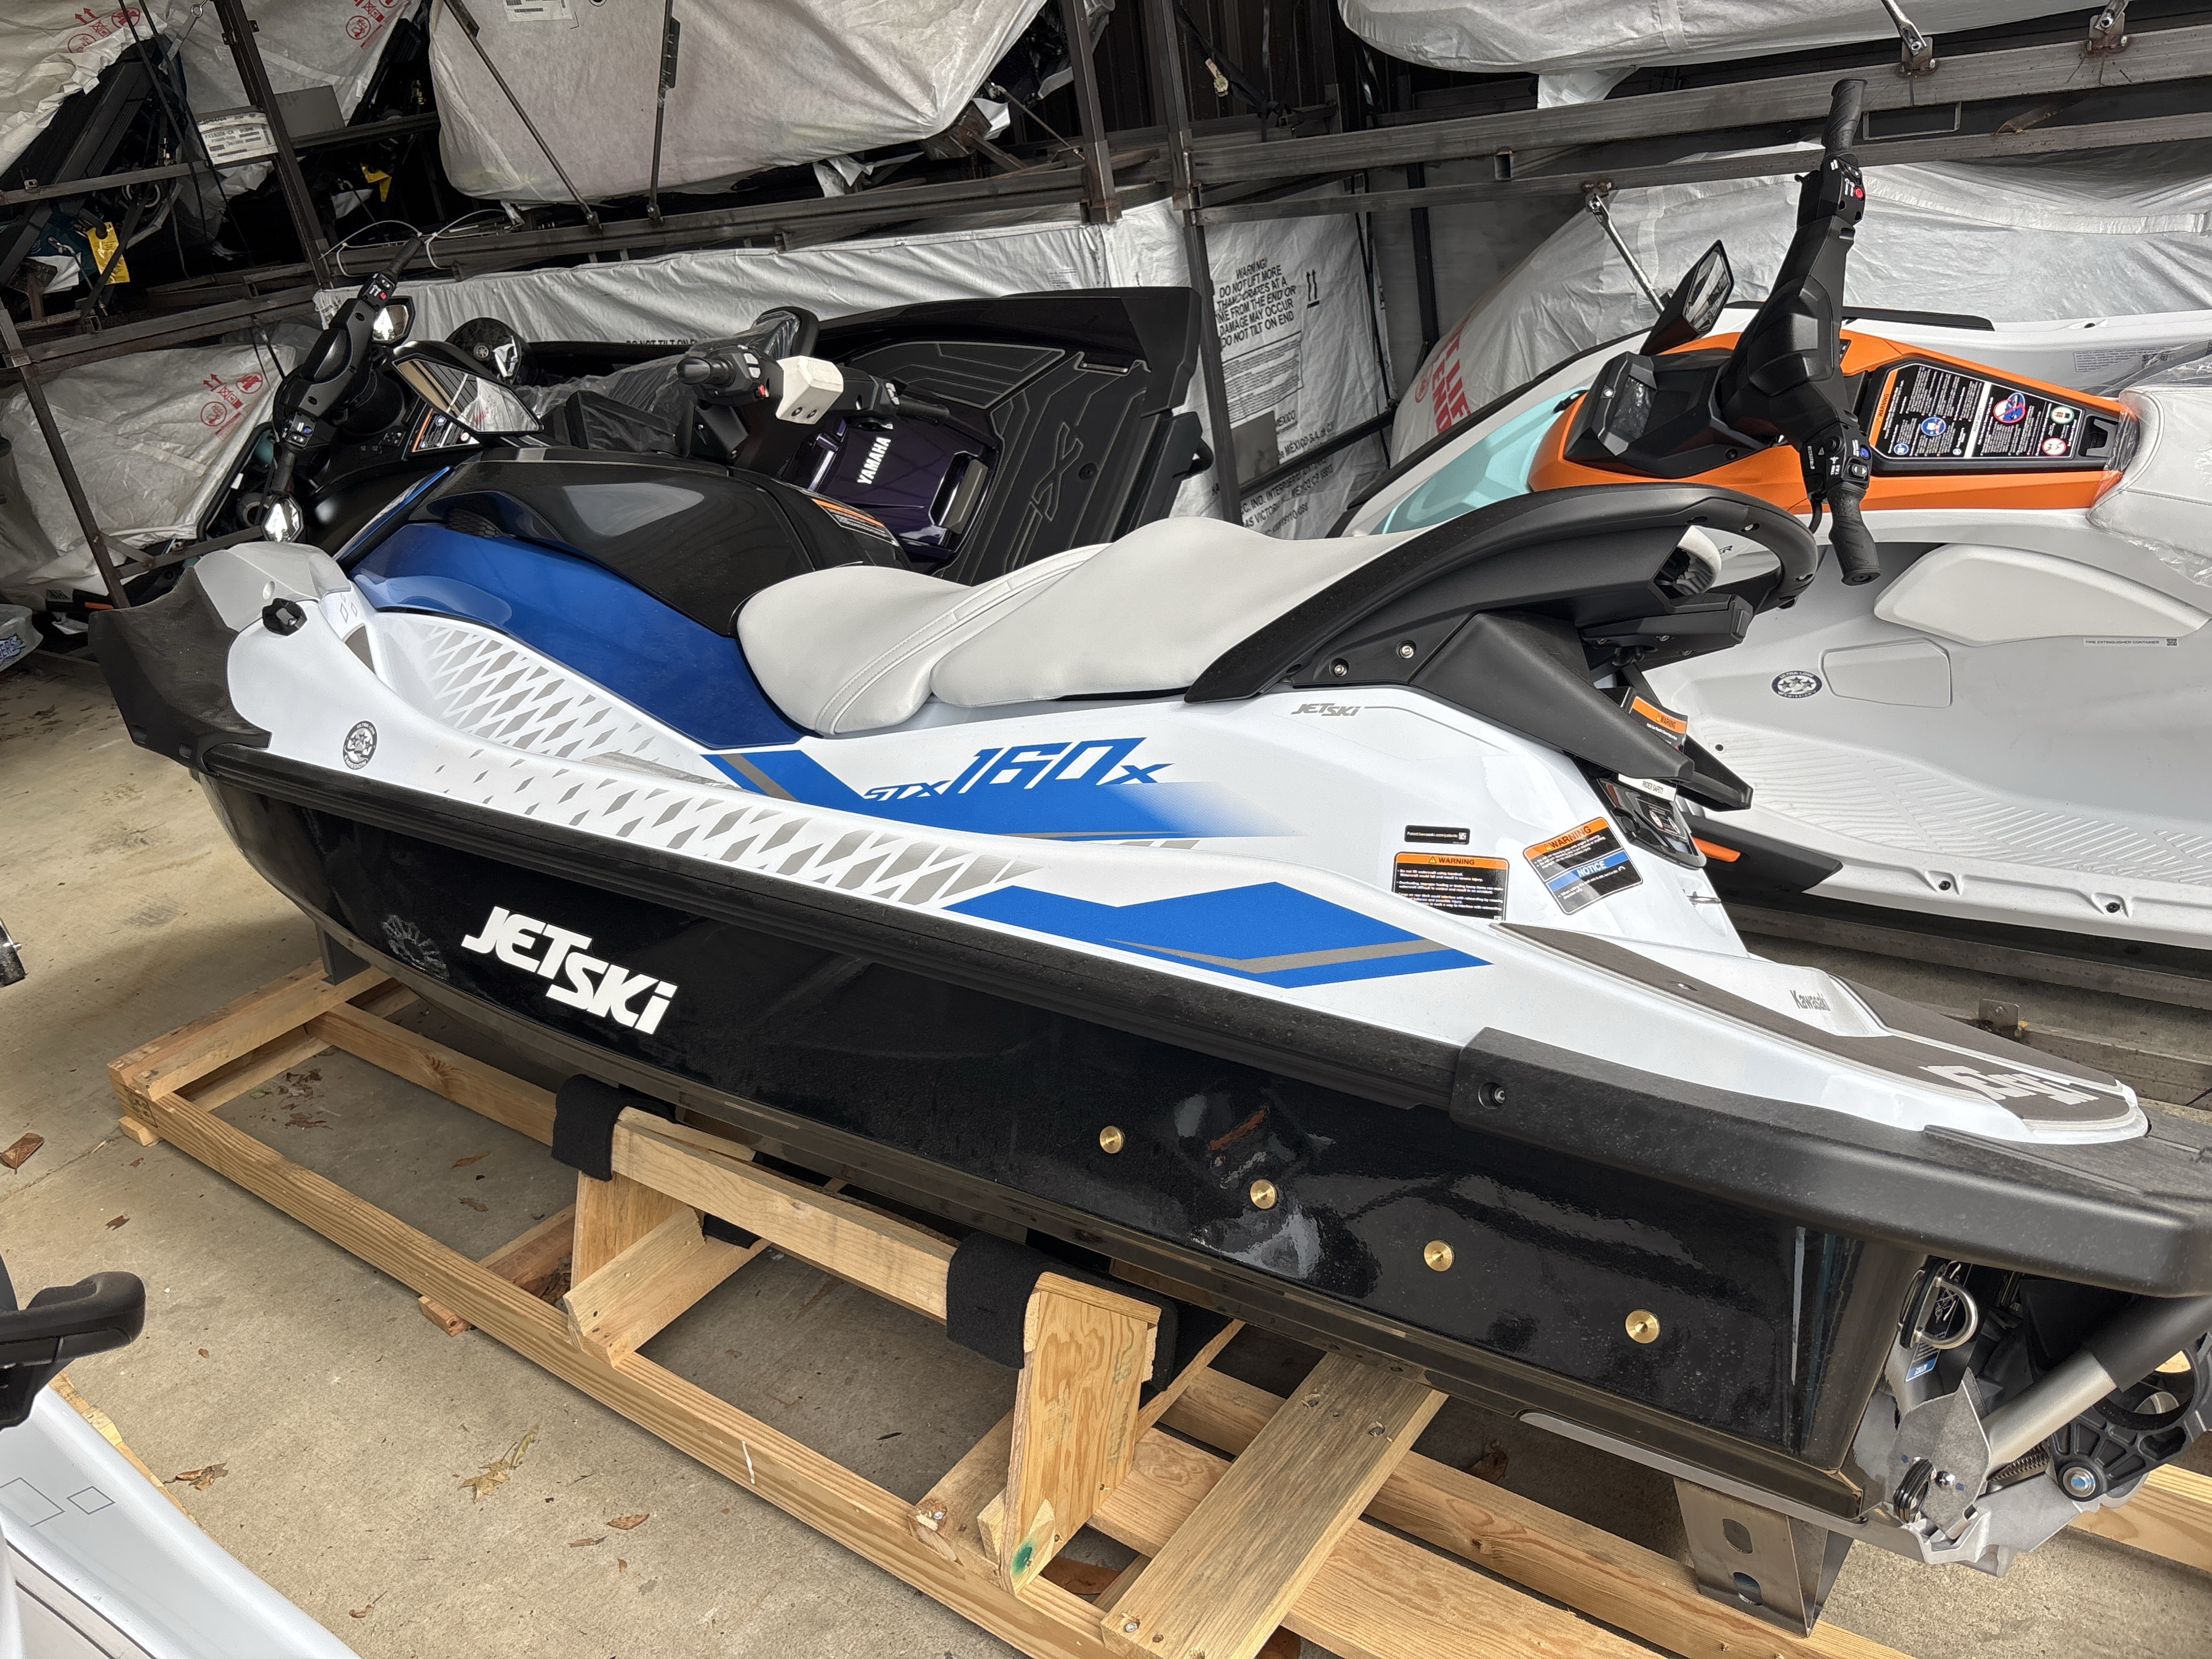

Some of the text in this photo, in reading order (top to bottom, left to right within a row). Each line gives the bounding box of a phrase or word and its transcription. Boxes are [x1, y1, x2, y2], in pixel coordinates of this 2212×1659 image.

[1220, 265, 1282, 298] DO NOT LIFT MORE
[1271, 277, 1280, 289] AT
[1282, 276, 1287, 286] A
[1230, 302, 1250, 317] FROM
[1251, 296, 1265, 309] THE
[1267, 290, 1283, 306] END
[1284, 285, 1296, 297] OR
[1220, 298, 1294, 336] DAMAGE MAY OCCUR
[1221, 311, 1294, 348] DO NOT TILT ON END
[1878, 393, 1889, 418] WARNING
[857, 437, 891, 484] YAMAHA
[1550, 826, 1592, 849] WARNING
[1577, 860, 1607, 877] NOTICE
[1789, 990, 1830, 1011] Kawasaki
